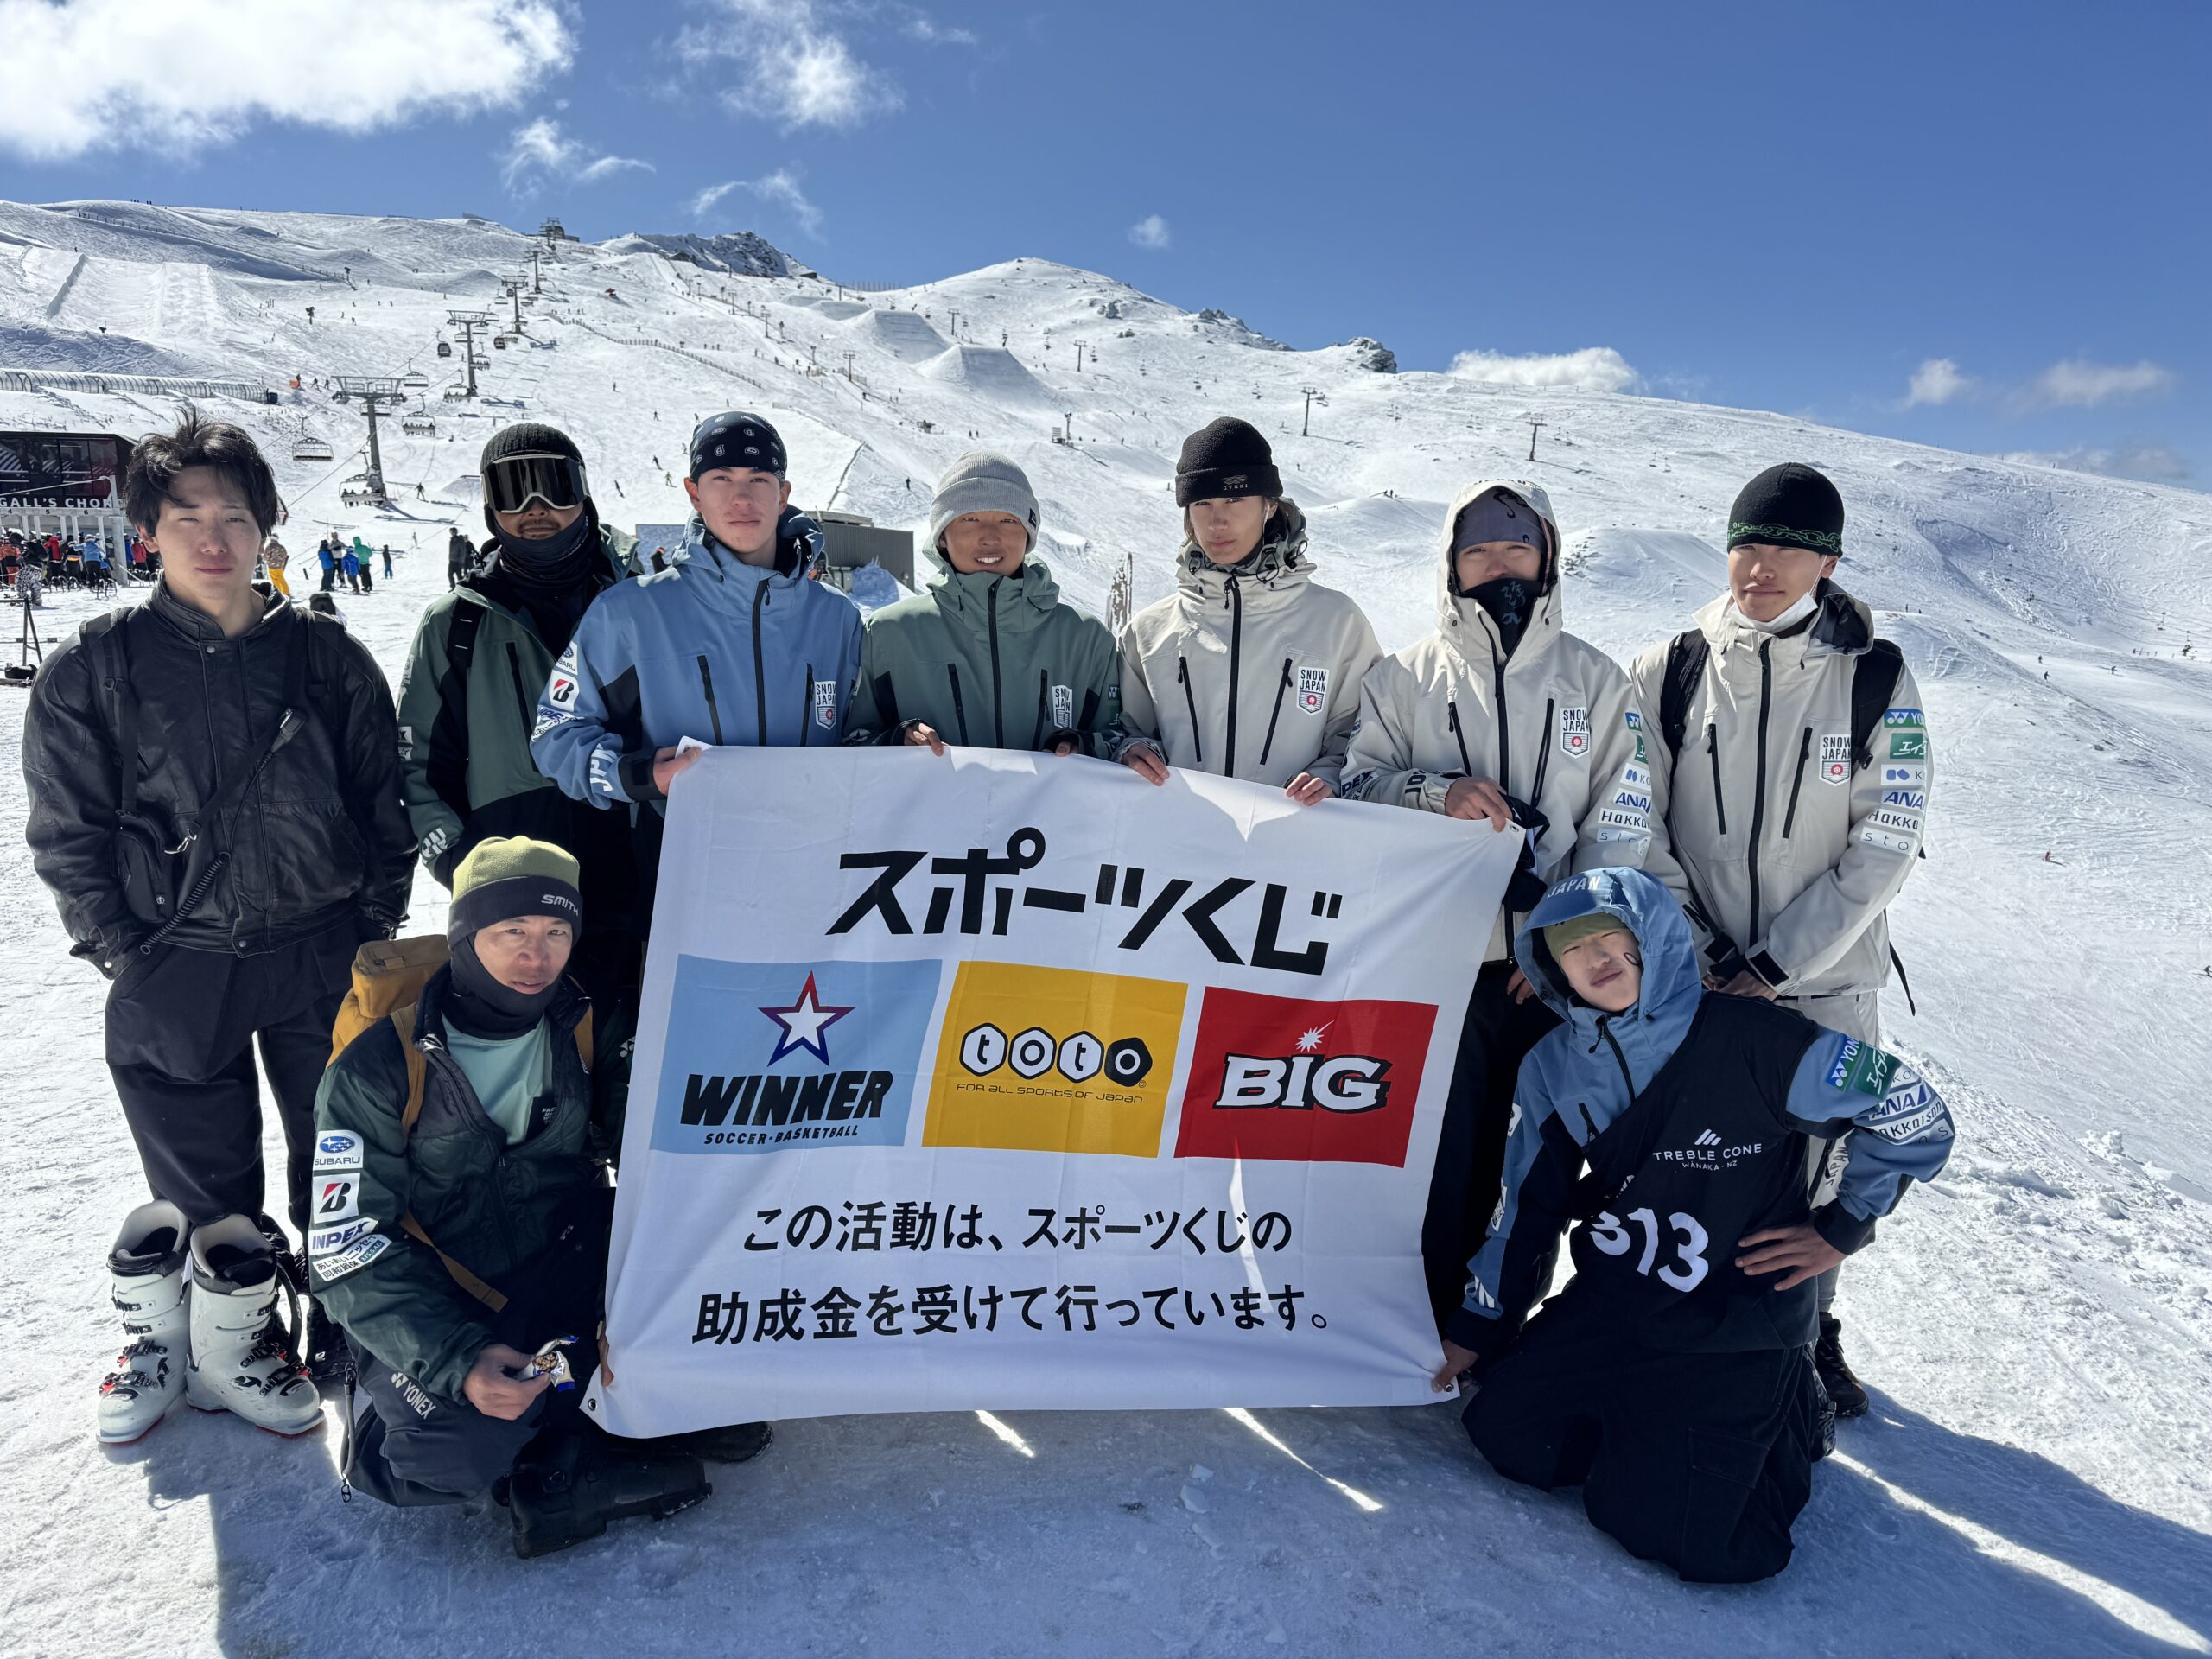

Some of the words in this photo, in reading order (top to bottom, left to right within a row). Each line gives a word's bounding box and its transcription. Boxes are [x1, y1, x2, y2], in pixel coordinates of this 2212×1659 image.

[1299, 680, 1325, 693] JAPAN
[1300, 669, 1326, 682] SNOW
[1562, 709, 1588, 721] SNOW
[1822, 736, 1851, 748] SNOW
[1547, 876, 1601, 899] JAPAN
[541, 894, 579, 917] SMITH
[825, 826, 1343, 976] スポーツくじ
[976, 1033, 1141, 1076] toto
[680, 1071, 893, 1126] WINNER
[957, 1083, 985, 1092] FOR
[315, 1156, 360, 1166] SUBARU
[1652, 1149, 1716, 1161] TREBLE
[1722, 1143, 1762, 1159] CONE
[312, 1221, 370, 1250] INPEX
[744, 1200, 1293, 1255] この活動は、スポーツくじの
[692, 1283, 1328, 1344] 助成金を受けて行っています。
[403, 1380, 437, 1420] YONEX
